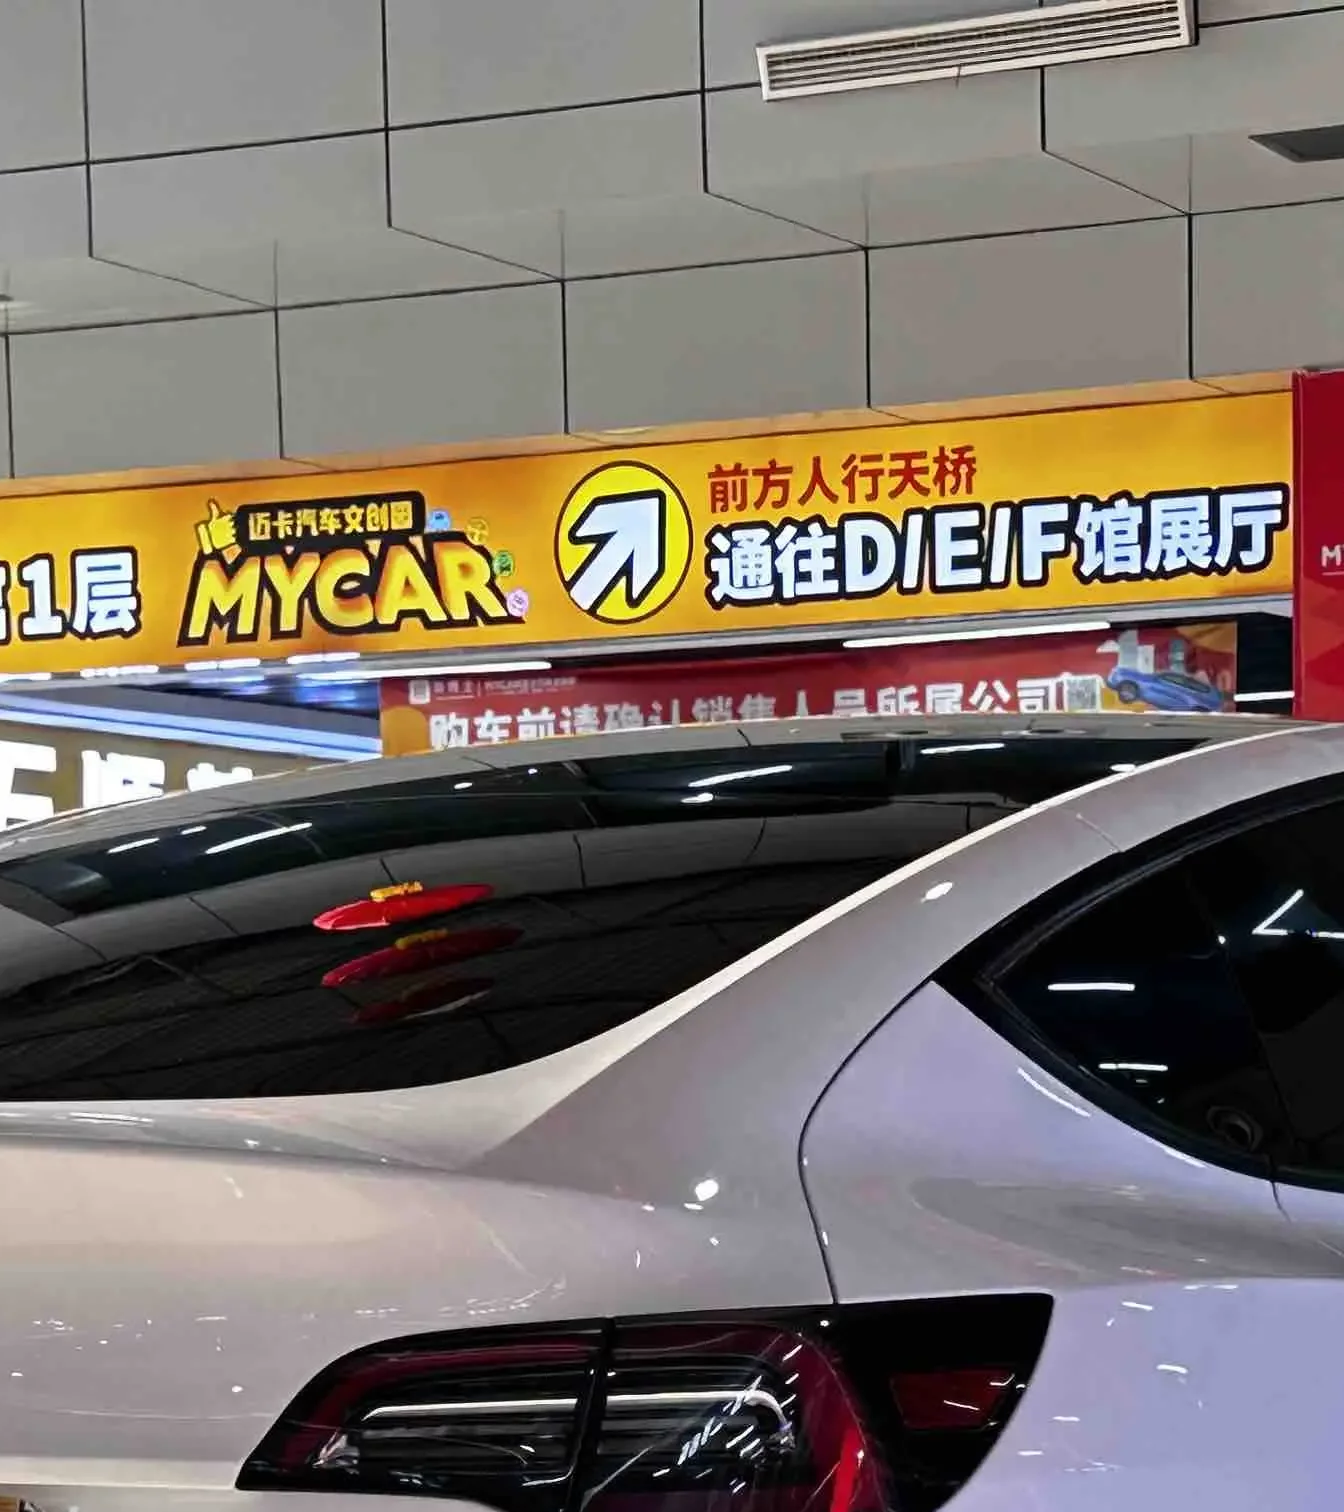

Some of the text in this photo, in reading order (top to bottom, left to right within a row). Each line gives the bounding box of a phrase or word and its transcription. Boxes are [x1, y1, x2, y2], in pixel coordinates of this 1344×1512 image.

[707, 445, 976, 513] 前方人行天桥
[248, 503, 413, 541] 迈卡汽车文创园
[712, 488, 1283, 602] 通往D/E/F馆展厅
[186, 542, 507, 639] MYCAR
